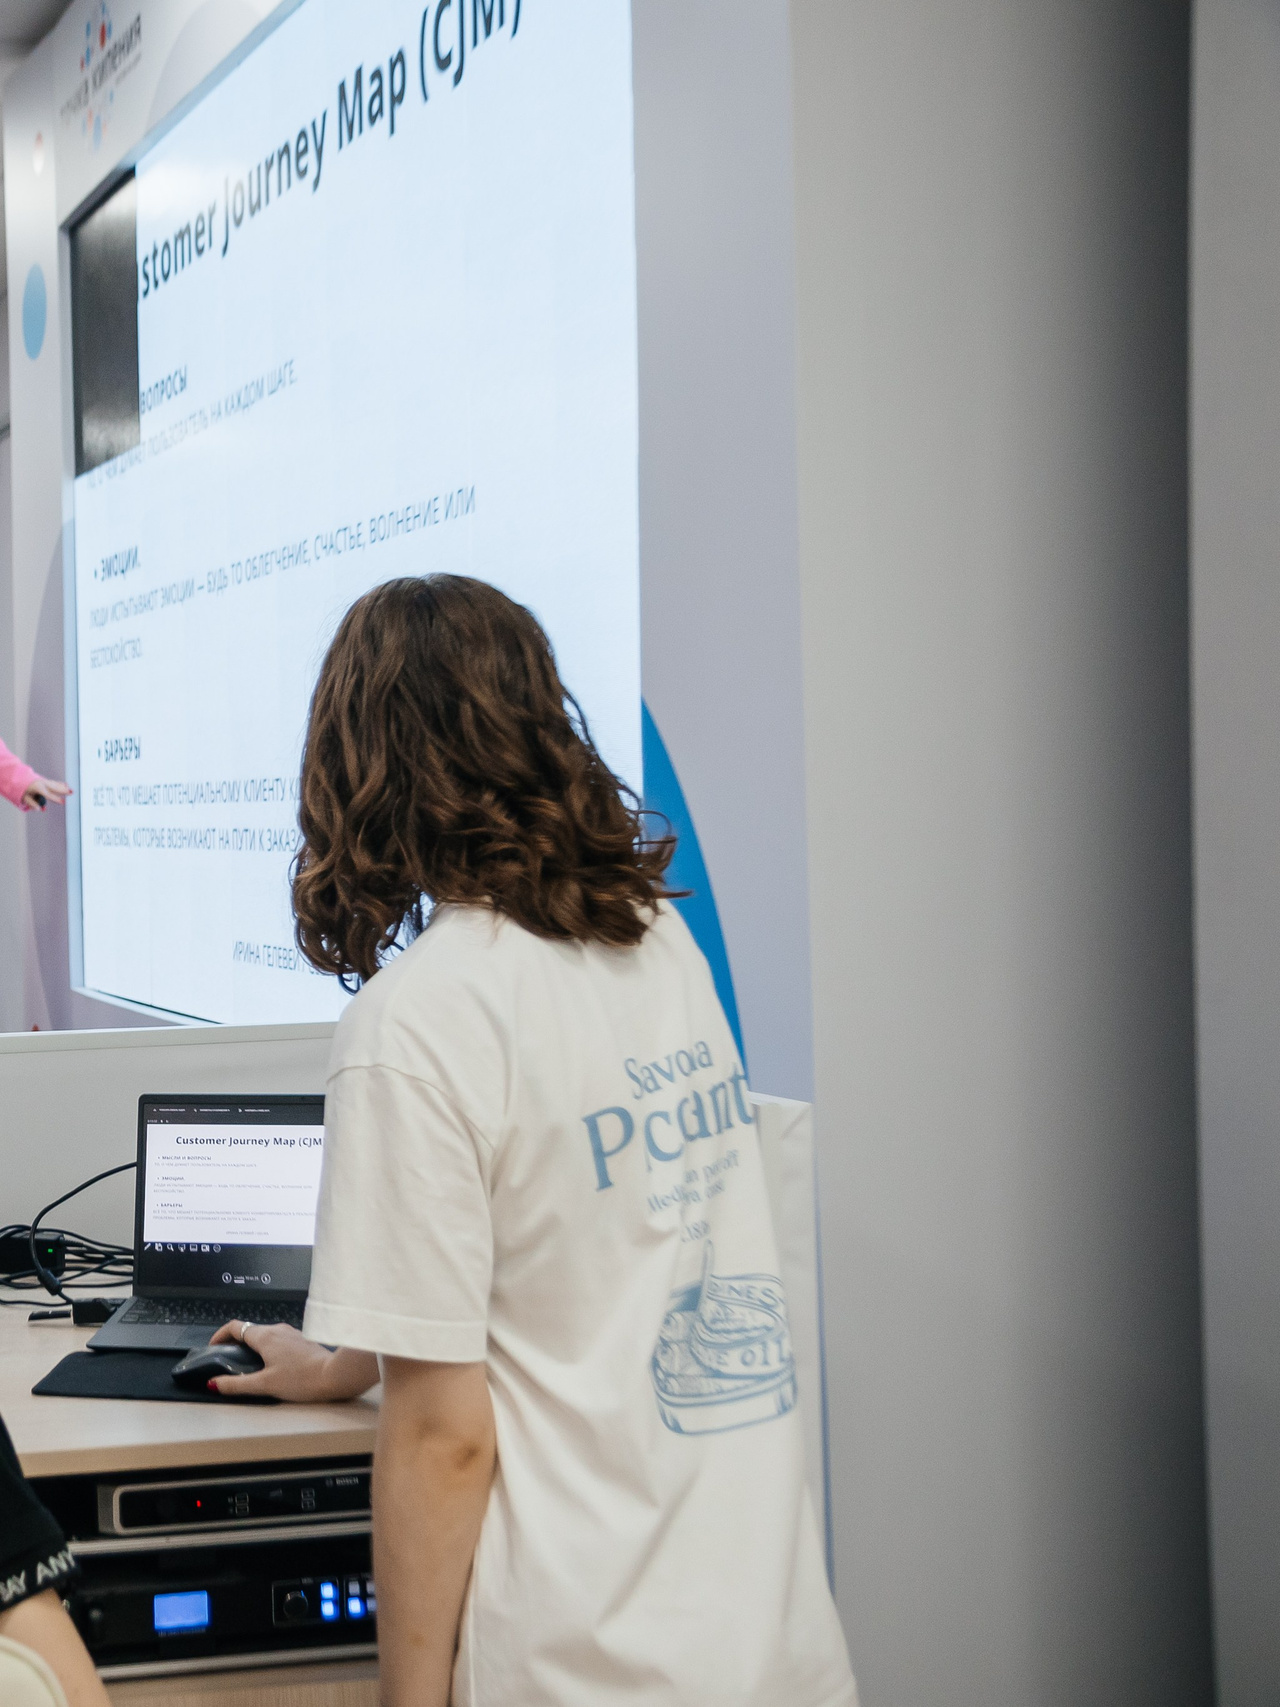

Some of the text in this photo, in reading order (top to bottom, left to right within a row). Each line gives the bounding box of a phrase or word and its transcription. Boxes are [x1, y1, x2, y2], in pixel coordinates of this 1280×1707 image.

[142, 197, 217, 299] stomer
[222, 108, 328, 258] Journey
[337, 46, 407, 151] Map
[140, 364, 188, 415] ВОПРОСЫ
[224, 376, 265, 416] КАЖДОМ
[160, 577, 195, 608] ЭМОЦИИ
[207, 566, 229, 598] БУДЬ
[231, 561, 243, 585] ТО
[244, 538, 311, 582] ОБЛЕГЧЕНИЕ,
[314, 521, 366, 560] СЧАСТЬЕ,
[369, 496, 440, 544] ВОЛНЕНИЕ
[444, 484, 477, 522] ИЛИ
[104, 736, 142, 763] БАРЬЕРЫ
[131, 784, 161, 806] МЕШАЕТ
[163, 779, 241, 809] ПОТЕНЦИАЛЬНОМУ
[244, 777, 286, 802] КЛИЕНТУ
[132, 826, 166, 850] КОТОРЫЕ
[167, 827, 216, 851] ВОЗНИКАЮТ
[219, 827, 230, 851] НА
[231, 828, 256, 851] ПУТИ
[258, 828, 265, 851] К
[266, 828, 301, 852] ЗАКАЗ
[233, 939, 261, 965] ИРИНА
[175, 1136, 227, 1146] Customer
[228, 1137, 271, 1148] Journey
[273, 1137, 296, 1148] Map
